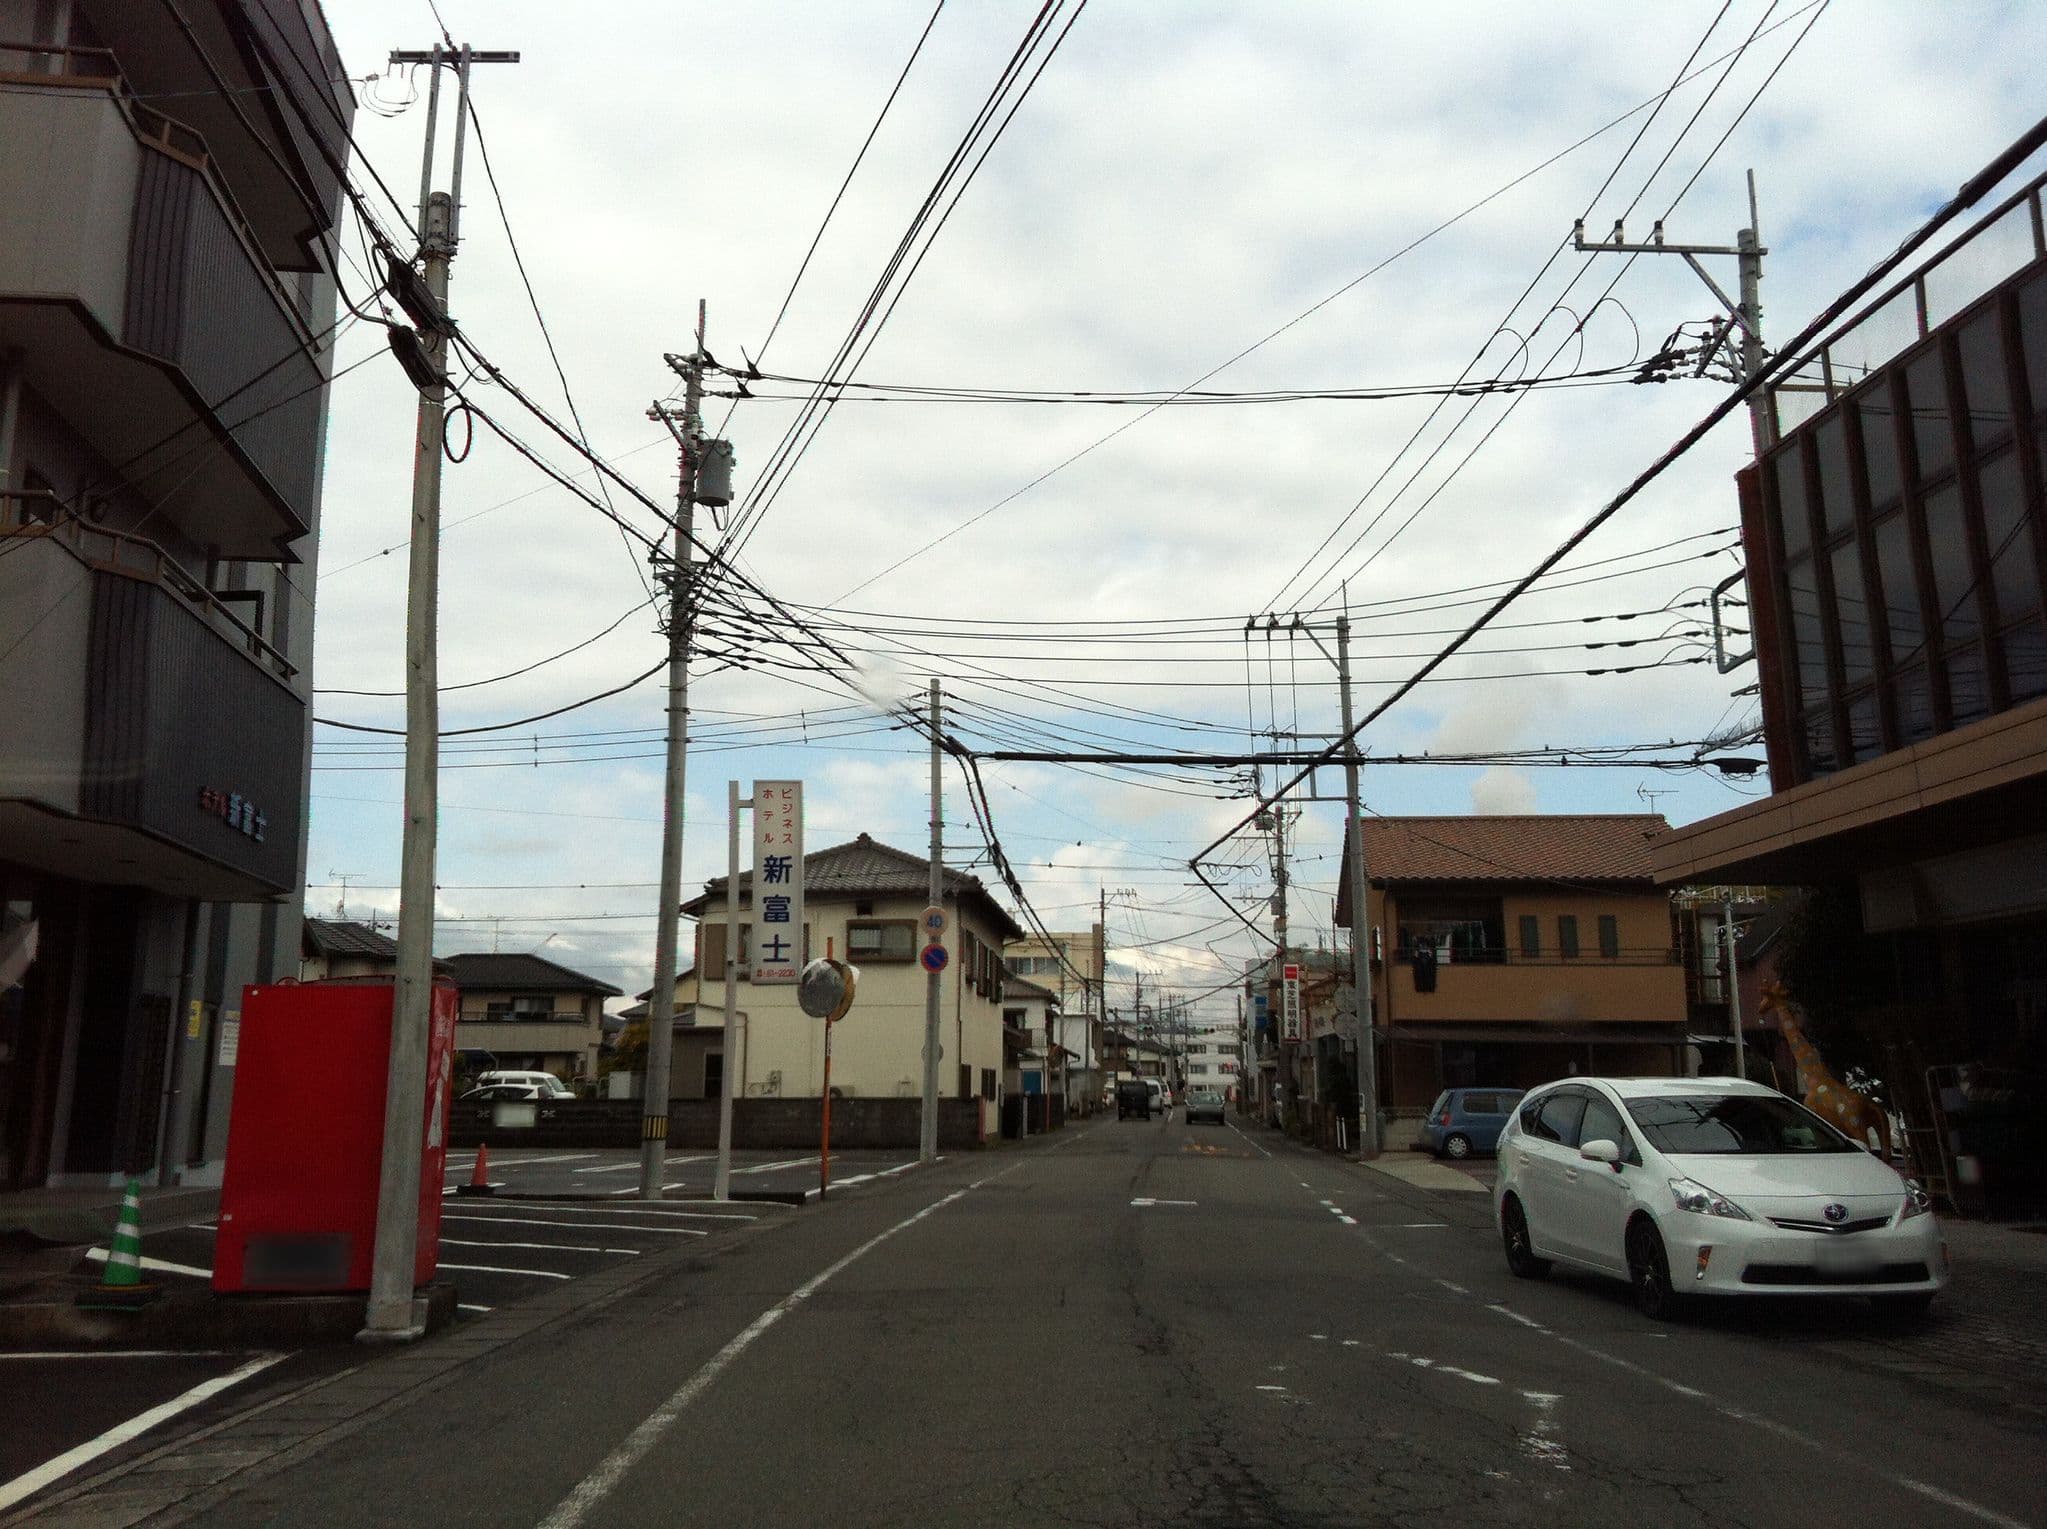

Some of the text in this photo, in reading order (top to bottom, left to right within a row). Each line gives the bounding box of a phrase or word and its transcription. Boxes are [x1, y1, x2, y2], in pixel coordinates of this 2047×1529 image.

[762, 789, 774, 844] ホテル
[782, 788, 793, 844] ビジネス
[762, 855, 793, 962] 新富士
[928, 914, 943, 928] 40
